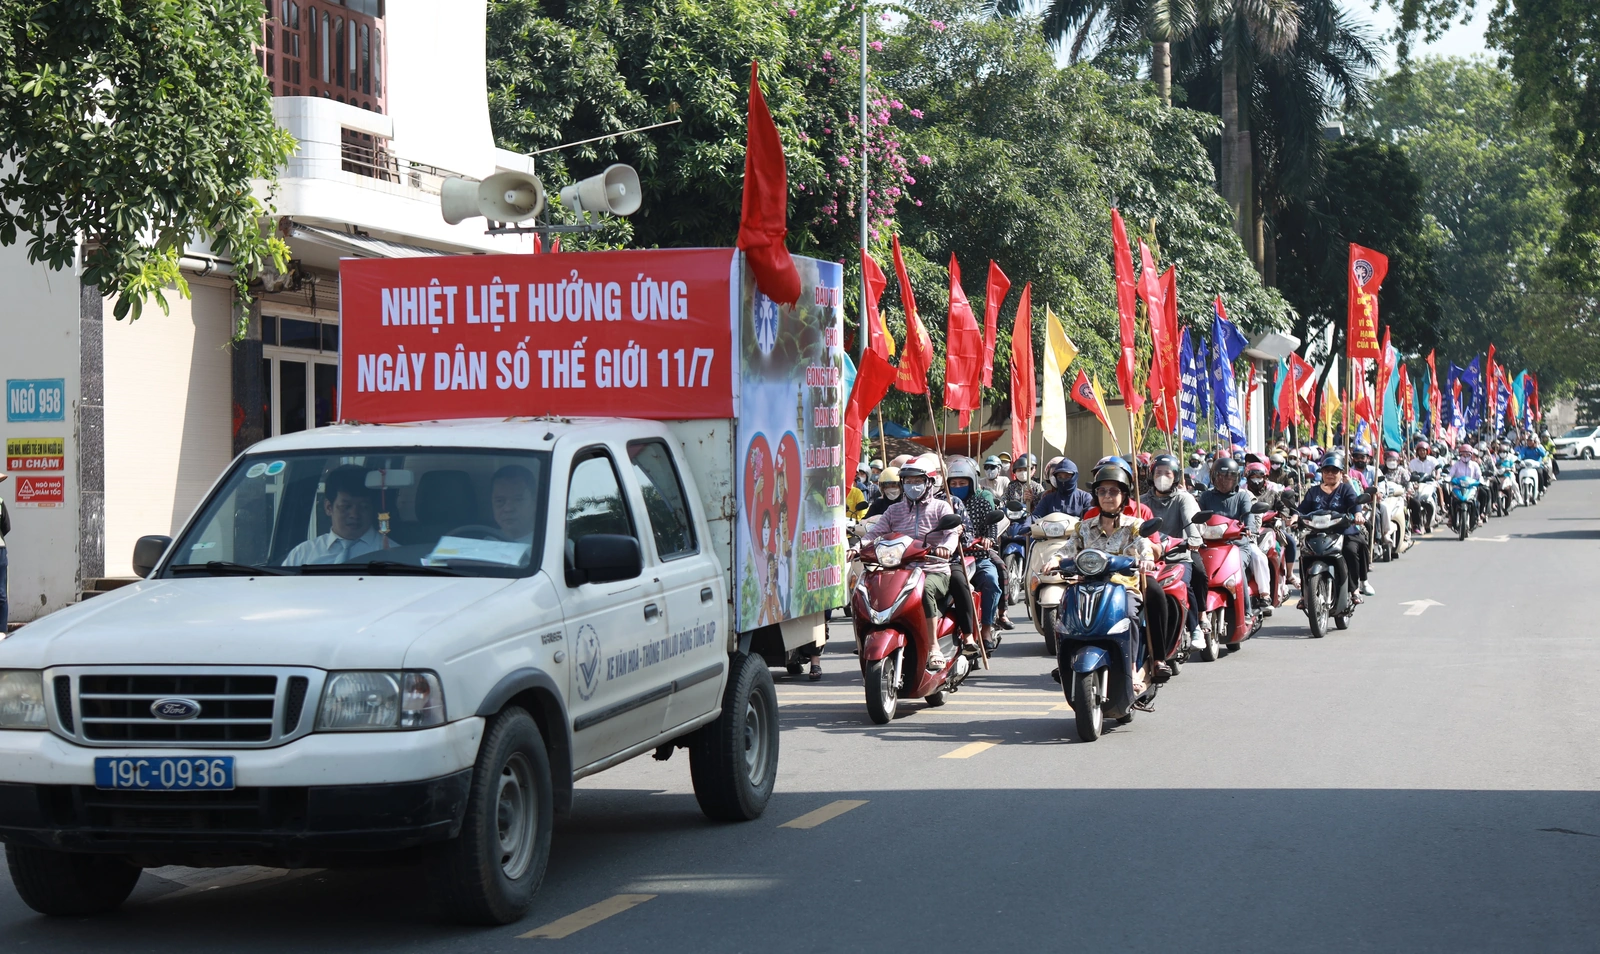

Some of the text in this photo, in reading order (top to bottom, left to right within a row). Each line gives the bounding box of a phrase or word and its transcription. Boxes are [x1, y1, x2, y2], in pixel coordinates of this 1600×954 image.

[381, 277, 458, 334] NHIỆT
[466, 275, 520, 332] LIỆT
[528, 269, 622, 322] HƯỞNG
[631, 273, 688, 321] ỨNG
[829, 286, 839, 308] TƯ
[825, 327, 838, 347] CHO
[357, 336, 714, 393] NGÀY DÂN SỐ THẾ GIỚI 11/7
[806, 363, 839, 388] CÔNG TÁC
[10, 383, 61, 414] NGÕ 958
[814, 403, 839, 428] DÂN SỐ
[11, 457, 59, 470] ĐI CHẬM
[806, 440, 841, 468] LÀ ĐẦU TƯ
[50, 487, 61, 496] TỐC
[826, 485, 840, 507] CHO
[801, 520, 841, 552] PHÁT TRIỂN
[807, 563, 842, 592] BỀN VỮNG
[606, 656, 614, 681] XE
[615, 649, 627, 678] VĂN
[642, 638, 660, 668] THÔNG
[679, 626, 692, 658] ĐỘNG
[693, 617, 705, 649] TỔNG
[706, 620, 716, 648] HỢP
[162, 703, 186, 714] Ford
[108, 759, 226, 788] 19C-0936
